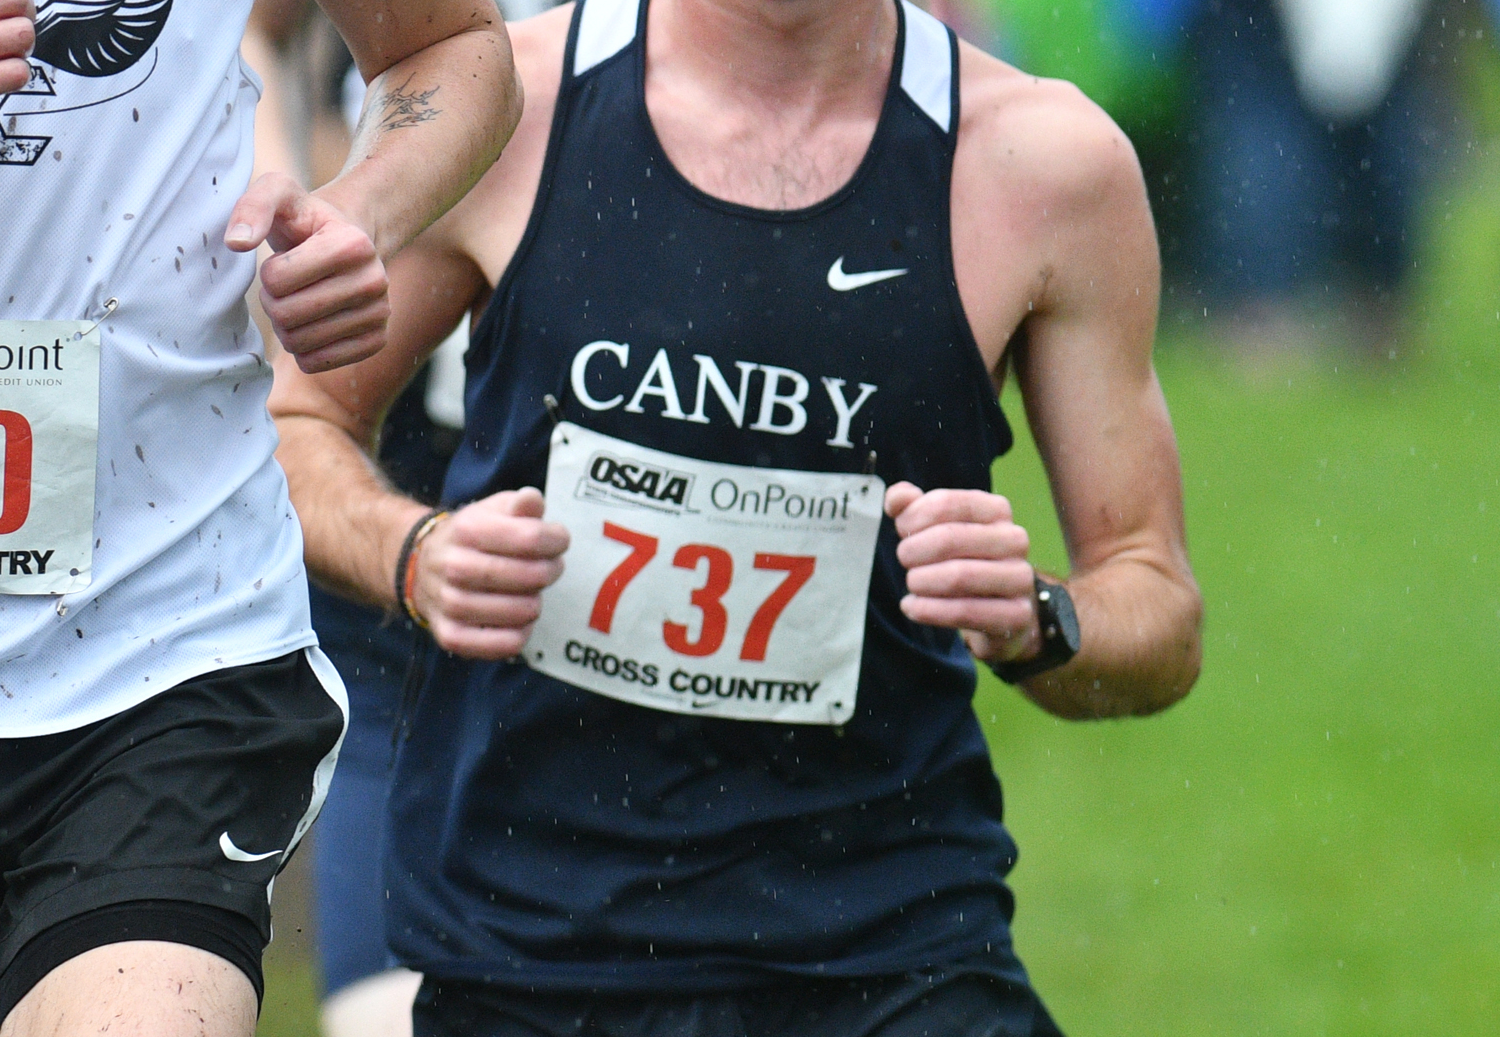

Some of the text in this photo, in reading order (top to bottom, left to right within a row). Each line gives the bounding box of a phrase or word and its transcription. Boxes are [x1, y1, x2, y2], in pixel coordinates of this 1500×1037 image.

[26, 378, 63, 386] UNION
[570, 340, 878, 448] CANBY
[590, 457, 689, 505] OSAA
[710, 477, 851, 521] OnPoint
[588, 520, 817, 663] 737
[565, 640, 821, 704] CROSS COUNTRY
